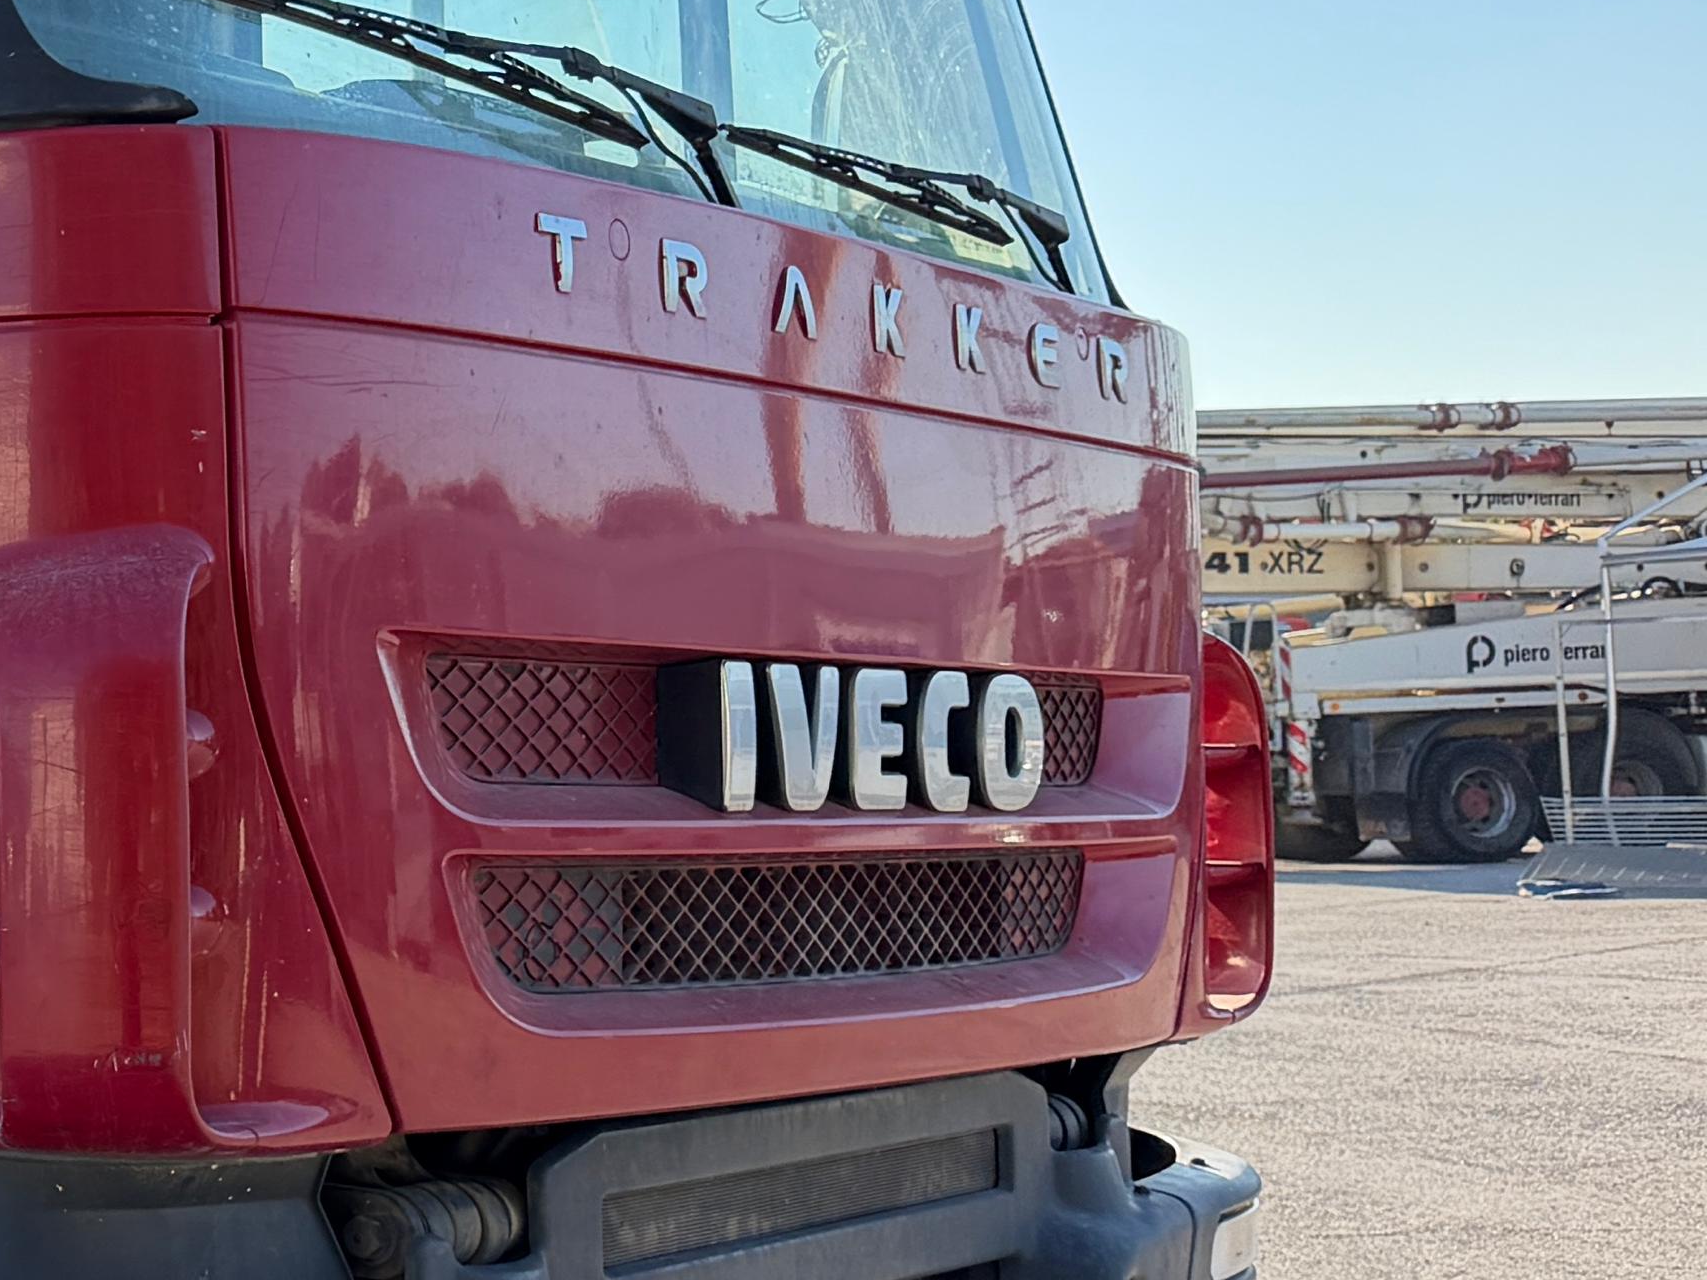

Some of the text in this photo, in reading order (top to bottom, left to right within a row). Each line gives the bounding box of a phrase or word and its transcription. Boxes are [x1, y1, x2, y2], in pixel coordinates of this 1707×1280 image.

[535, 211, 1130, 404] TRAKKER
[1204, 551, 1325, 574] 41 XRZ
[1503, 644, 1551, 667] piero
[720, 659, 1045, 812] IVECO
